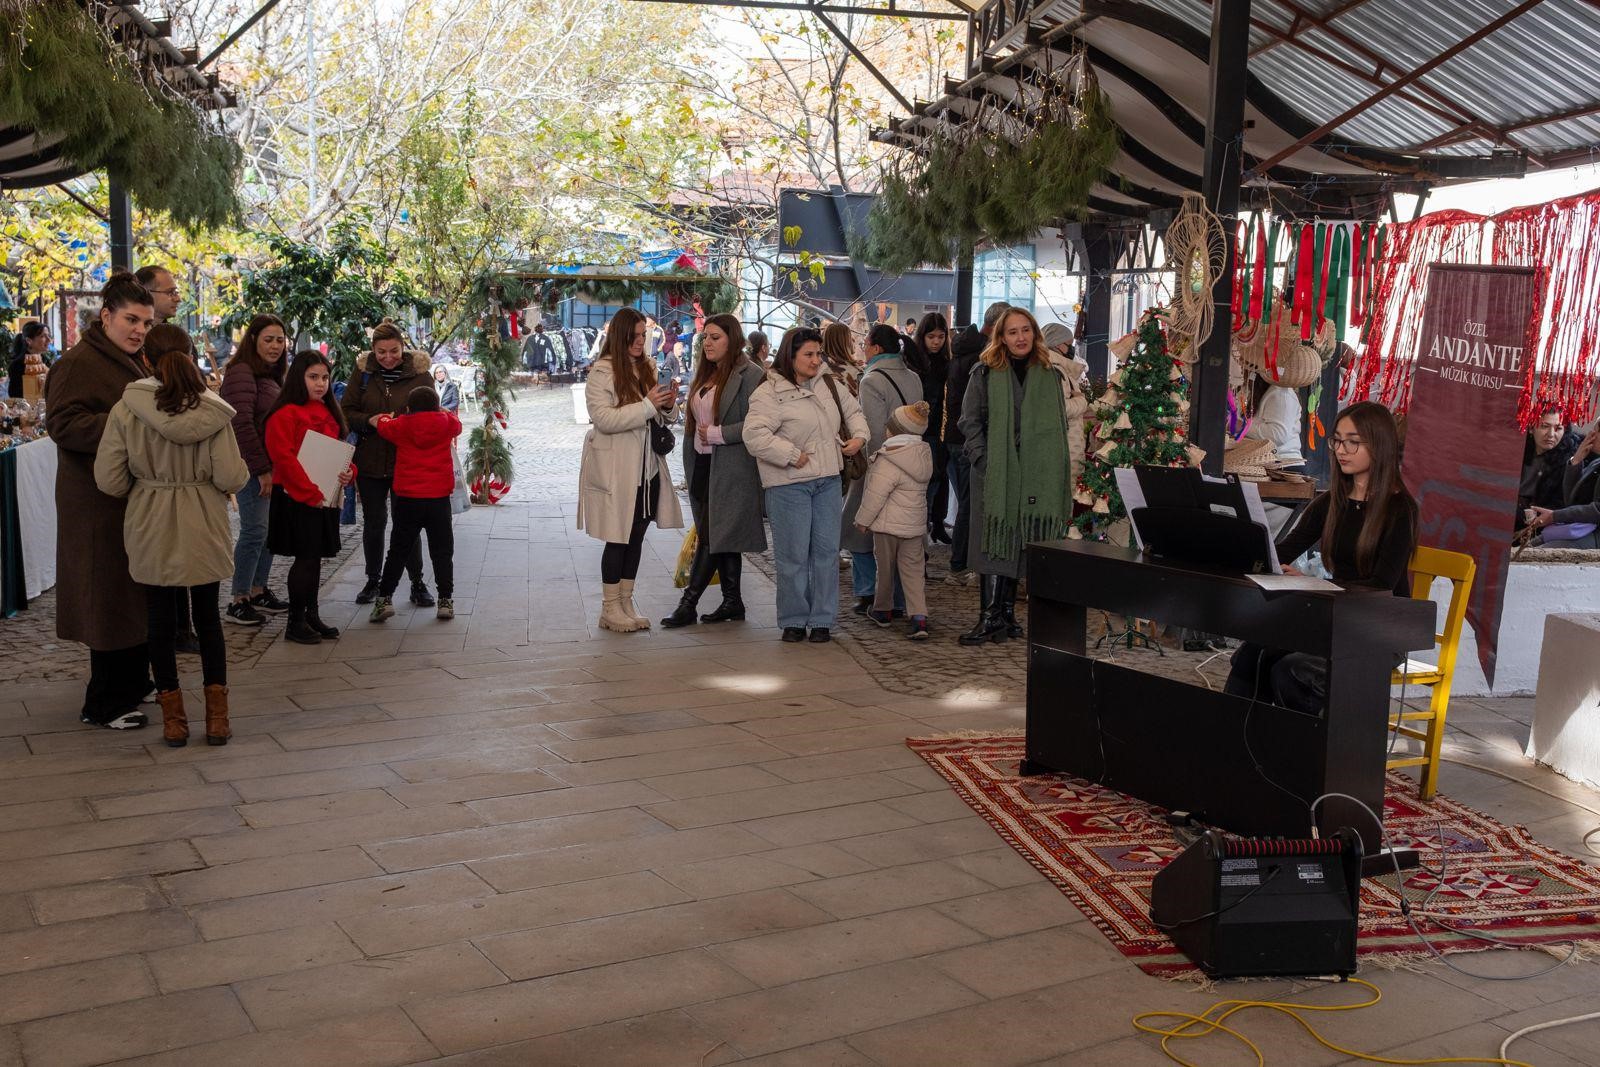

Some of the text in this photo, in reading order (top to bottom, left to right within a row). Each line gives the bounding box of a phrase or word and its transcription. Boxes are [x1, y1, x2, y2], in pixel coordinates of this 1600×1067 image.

[1463, 319, 1489, 338] ÖZEL
[1428, 334, 1524, 372] ANDANTE
[1440, 366, 1503, 390] MÜZİK KURSU
